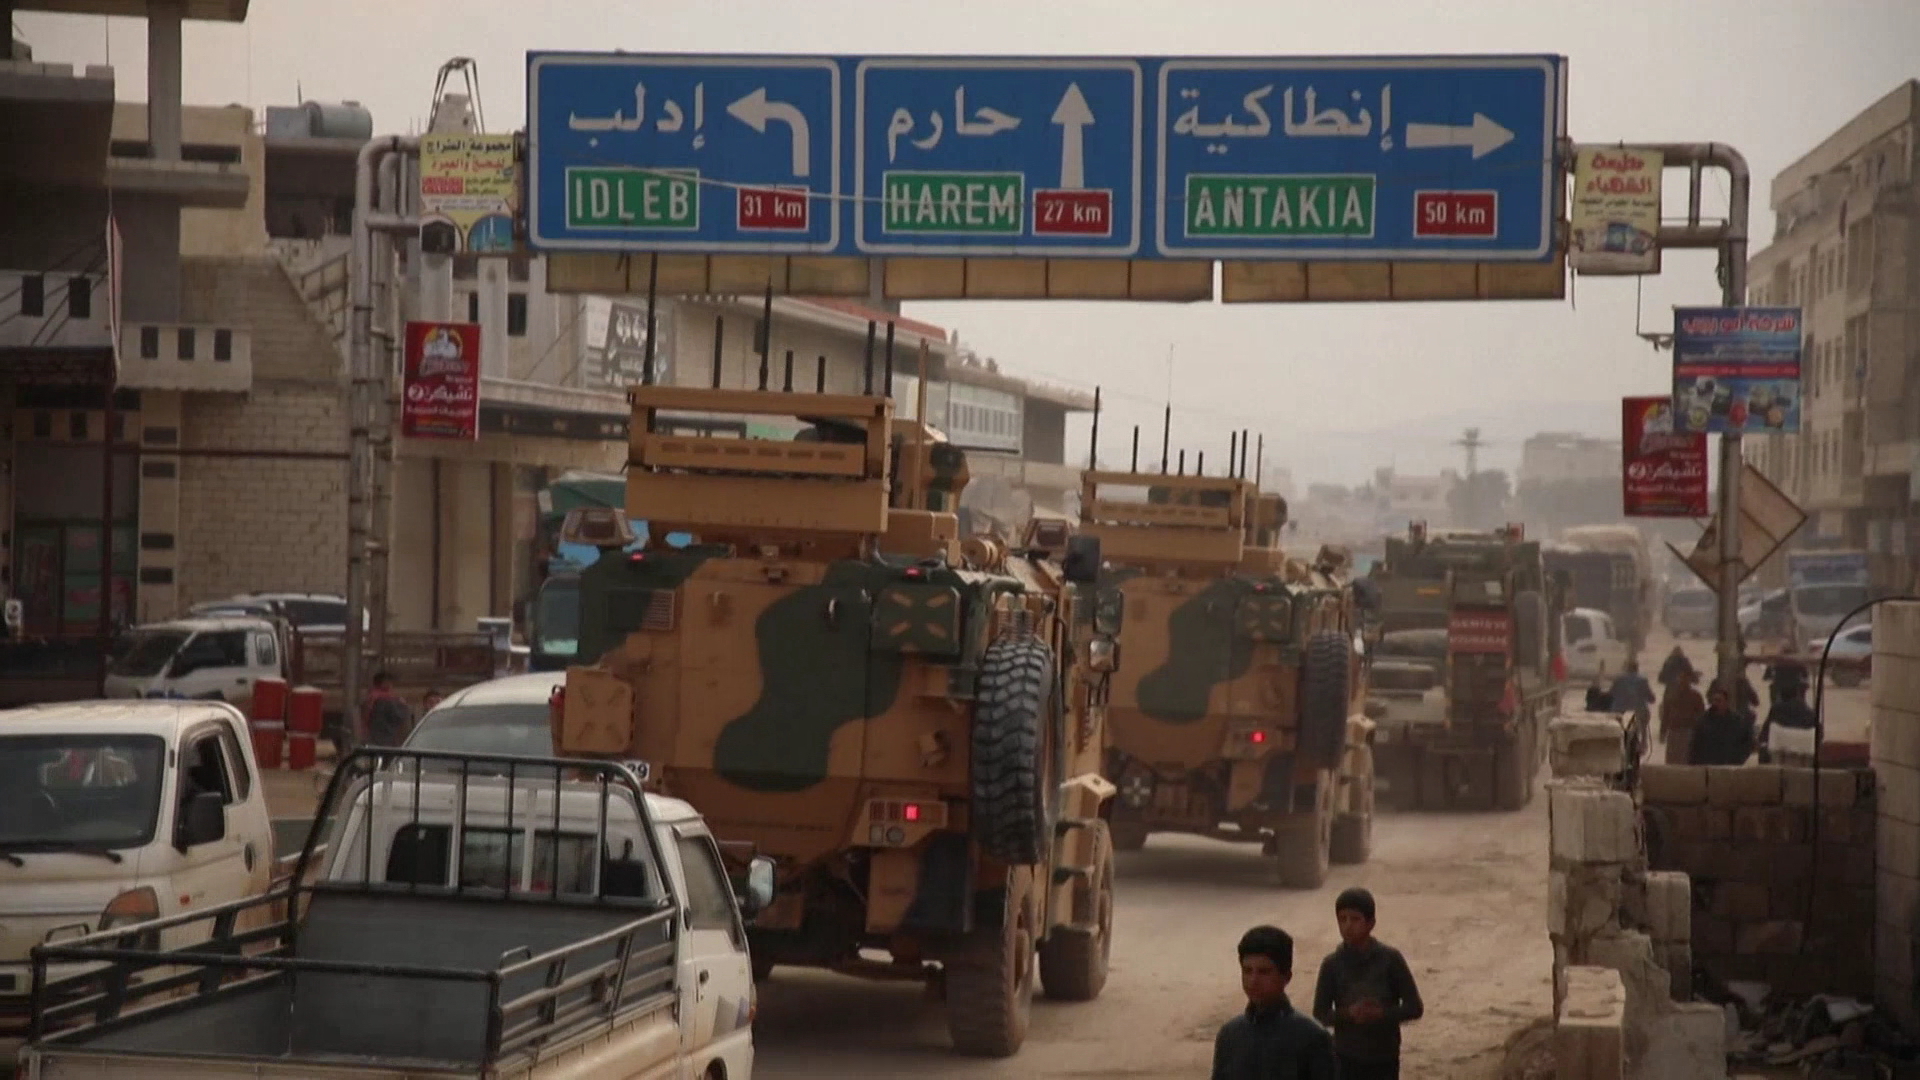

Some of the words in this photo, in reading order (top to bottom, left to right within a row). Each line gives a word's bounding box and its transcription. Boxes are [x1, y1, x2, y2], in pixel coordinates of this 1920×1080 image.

[569, 81, 705, 149] إدلب
[887, 84, 1022, 164] حارم
[1173, 83, 1394, 154] إنطاكية
[575, 177, 689, 220] IDLEB
[744, 196, 762, 217] 31
[774, 197, 801, 218] km
[890, 182, 1016, 225] HAREM
[1043, 202, 1064, 222] 27
[1073, 203, 1101, 222] km
[1195, 185, 1365, 228] ANTAKIA
[1425, 202, 1447, 223] 50
[1455, 202, 1486, 224] km
